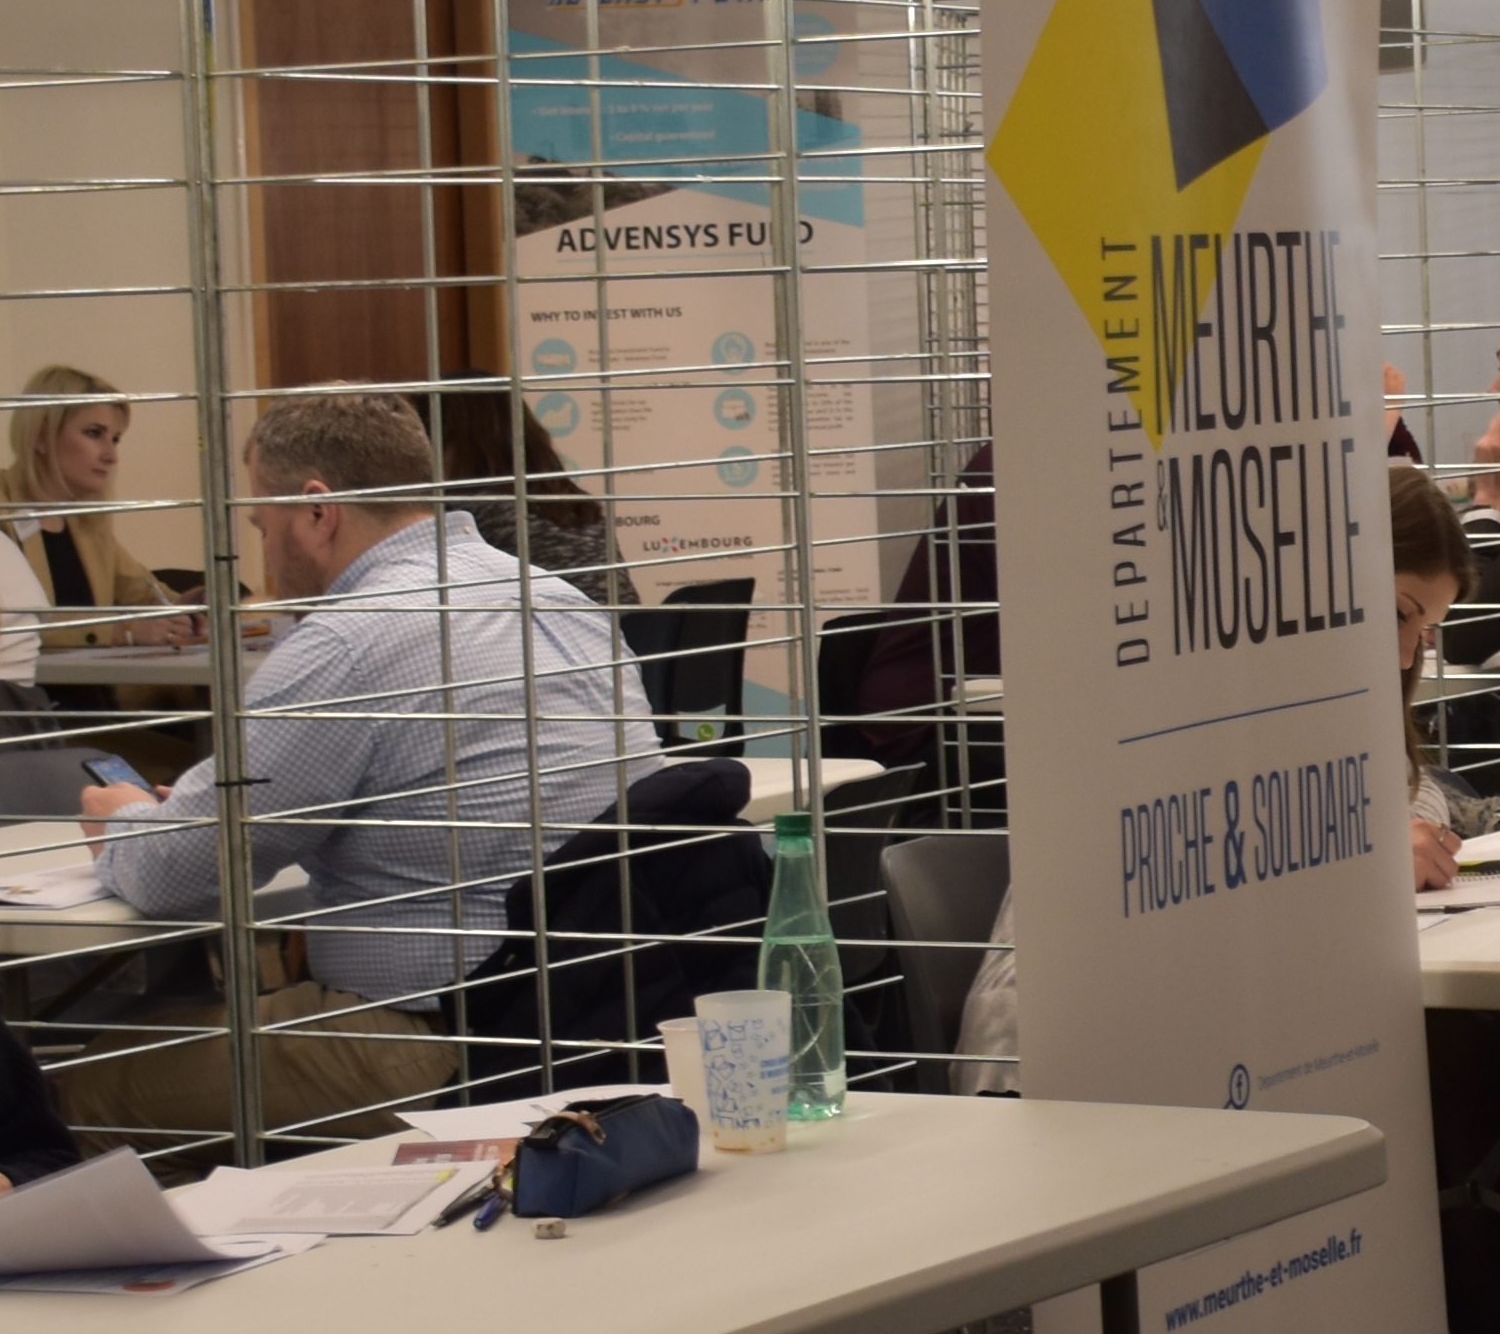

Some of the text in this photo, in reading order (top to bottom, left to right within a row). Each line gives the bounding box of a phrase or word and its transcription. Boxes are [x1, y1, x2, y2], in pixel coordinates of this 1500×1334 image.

[555, 219, 813, 254] ADVENSYS FUD
[530, 307, 683, 323] WHY TO INEST WITH US
[1150, 229, 1352, 436] MEURTHE
[1101, 235, 1151, 668] DEPARTEMENT
[614, 515, 661, 527] BOURG
[642, 536, 753, 554] LUXEMBOURG
[1155, 438, 1366, 656] & MOSELLE
[1119, 752, 1373, 919] PROCHE & SOLIDAIRE
[1163, 1227, 1364, 1332] www.meurthe-et-moselle.fr
